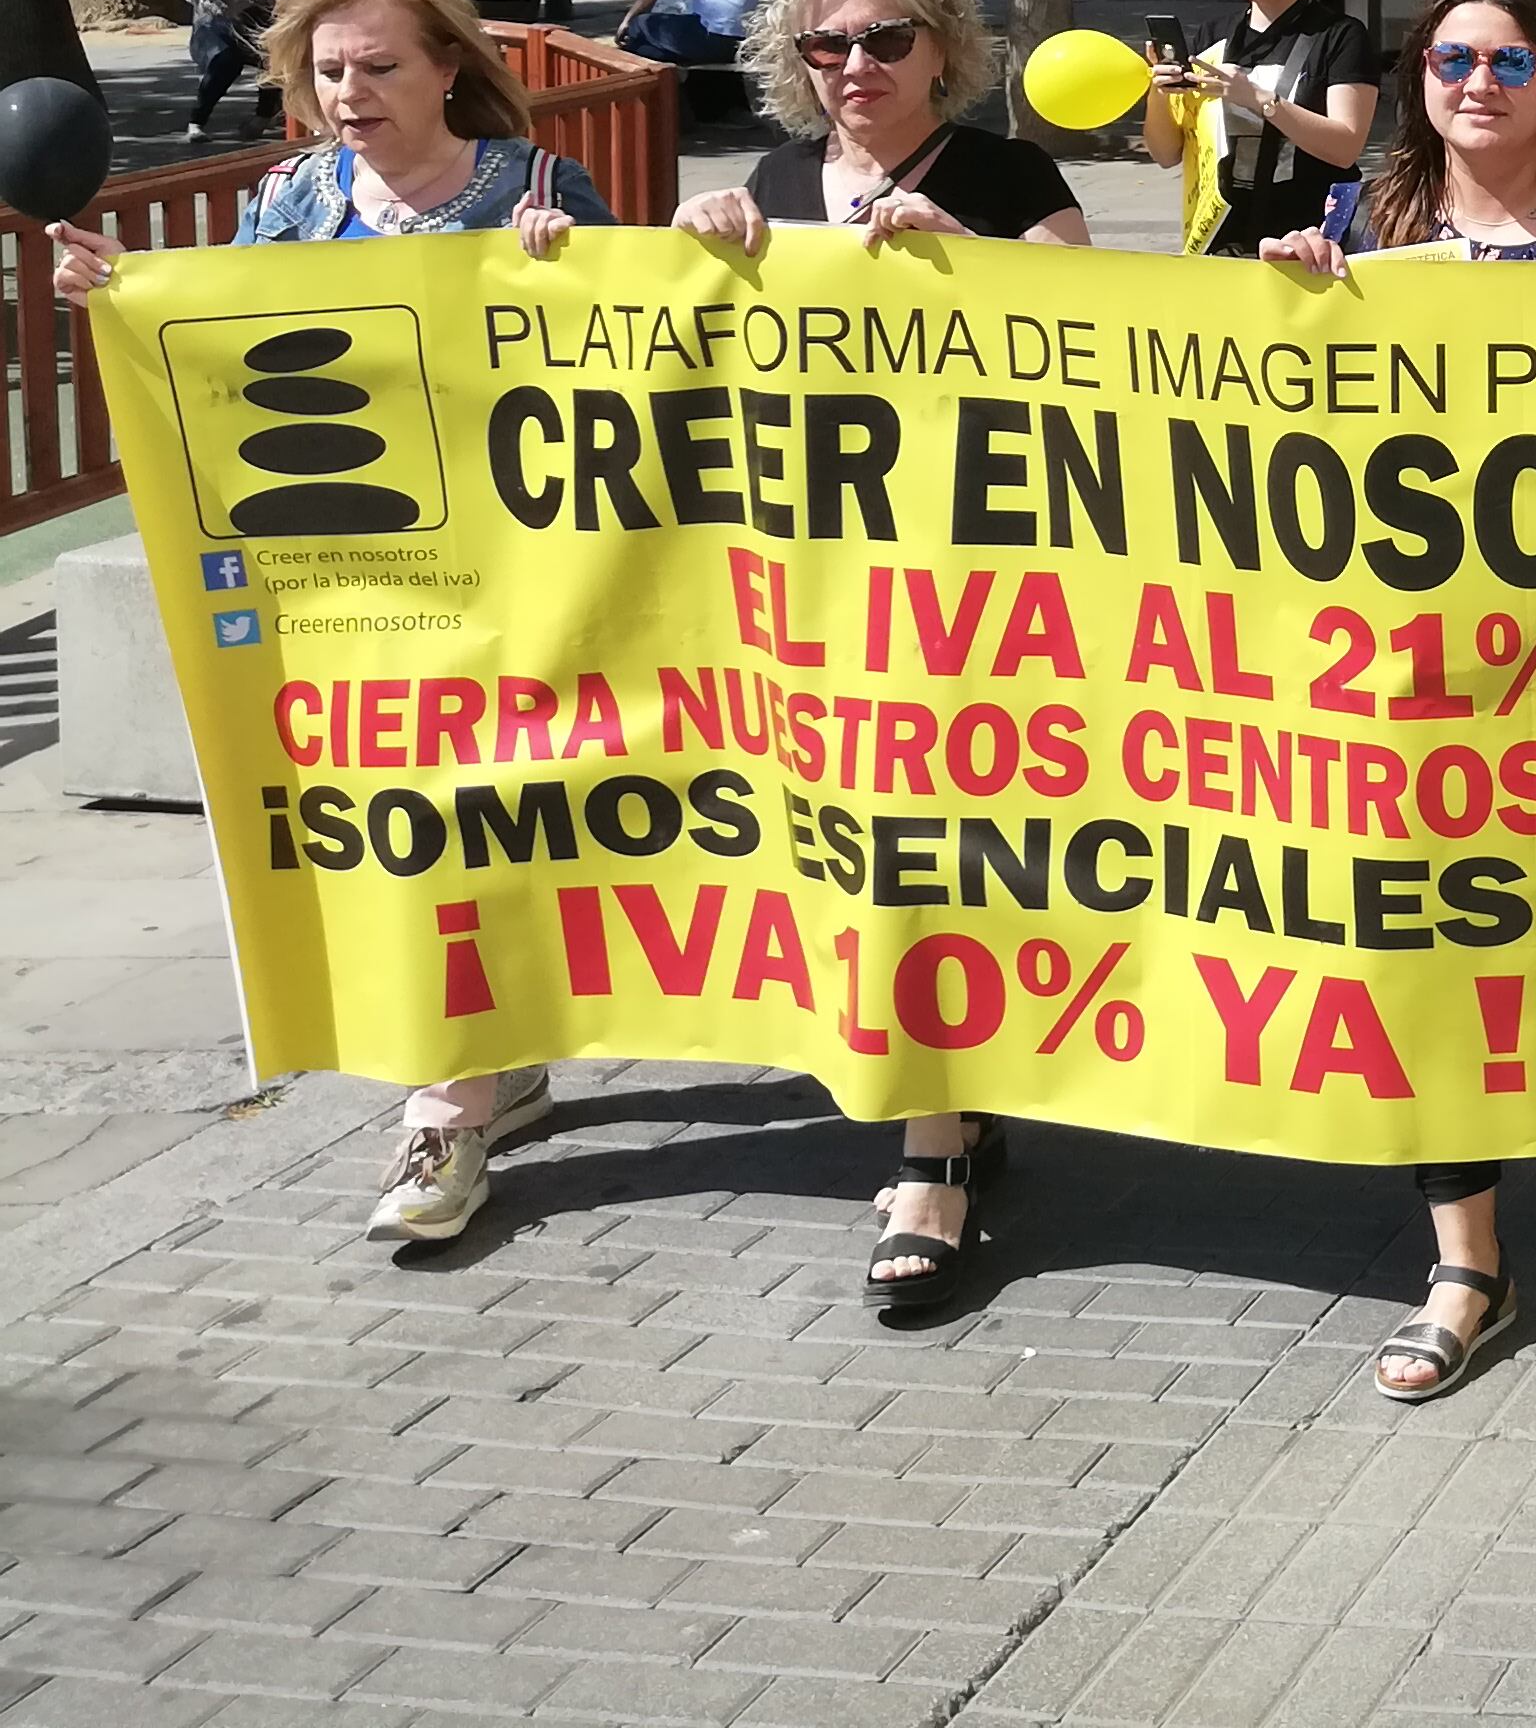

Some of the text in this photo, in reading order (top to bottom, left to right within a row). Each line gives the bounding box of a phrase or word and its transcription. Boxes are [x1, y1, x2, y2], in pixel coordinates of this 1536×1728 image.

[488, 303, 988, 375] PLATAFORMA
[1008, 314, 1098, 389] DE
[1130, 327, 1447, 416] IMAGEN
[488, 385, 902, 539] CREER
[952, 397, 1126, 557] EN
[257, 547, 438, 566] Creer en nosotros
[265, 569, 481, 595] (por la bajada del iva)
[275, 612, 462, 634] Creerennosotros
[728, 547, 825, 670] EL
[865, 567, 1087, 681] IVA
[1126, 584, 1273, 706] AL
[273, 670, 624, 768] CIERRA
[657, 667, 1089, 798] NUESTROS
[264, 770, 760, 877] ¡SOMOS
[559, 884, 818, 1015] IVA
[835, 925, 1146, 1062] 10%
[1193, 956, 1415, 1100] YA
[1475, 975, 1527, 1094] !
